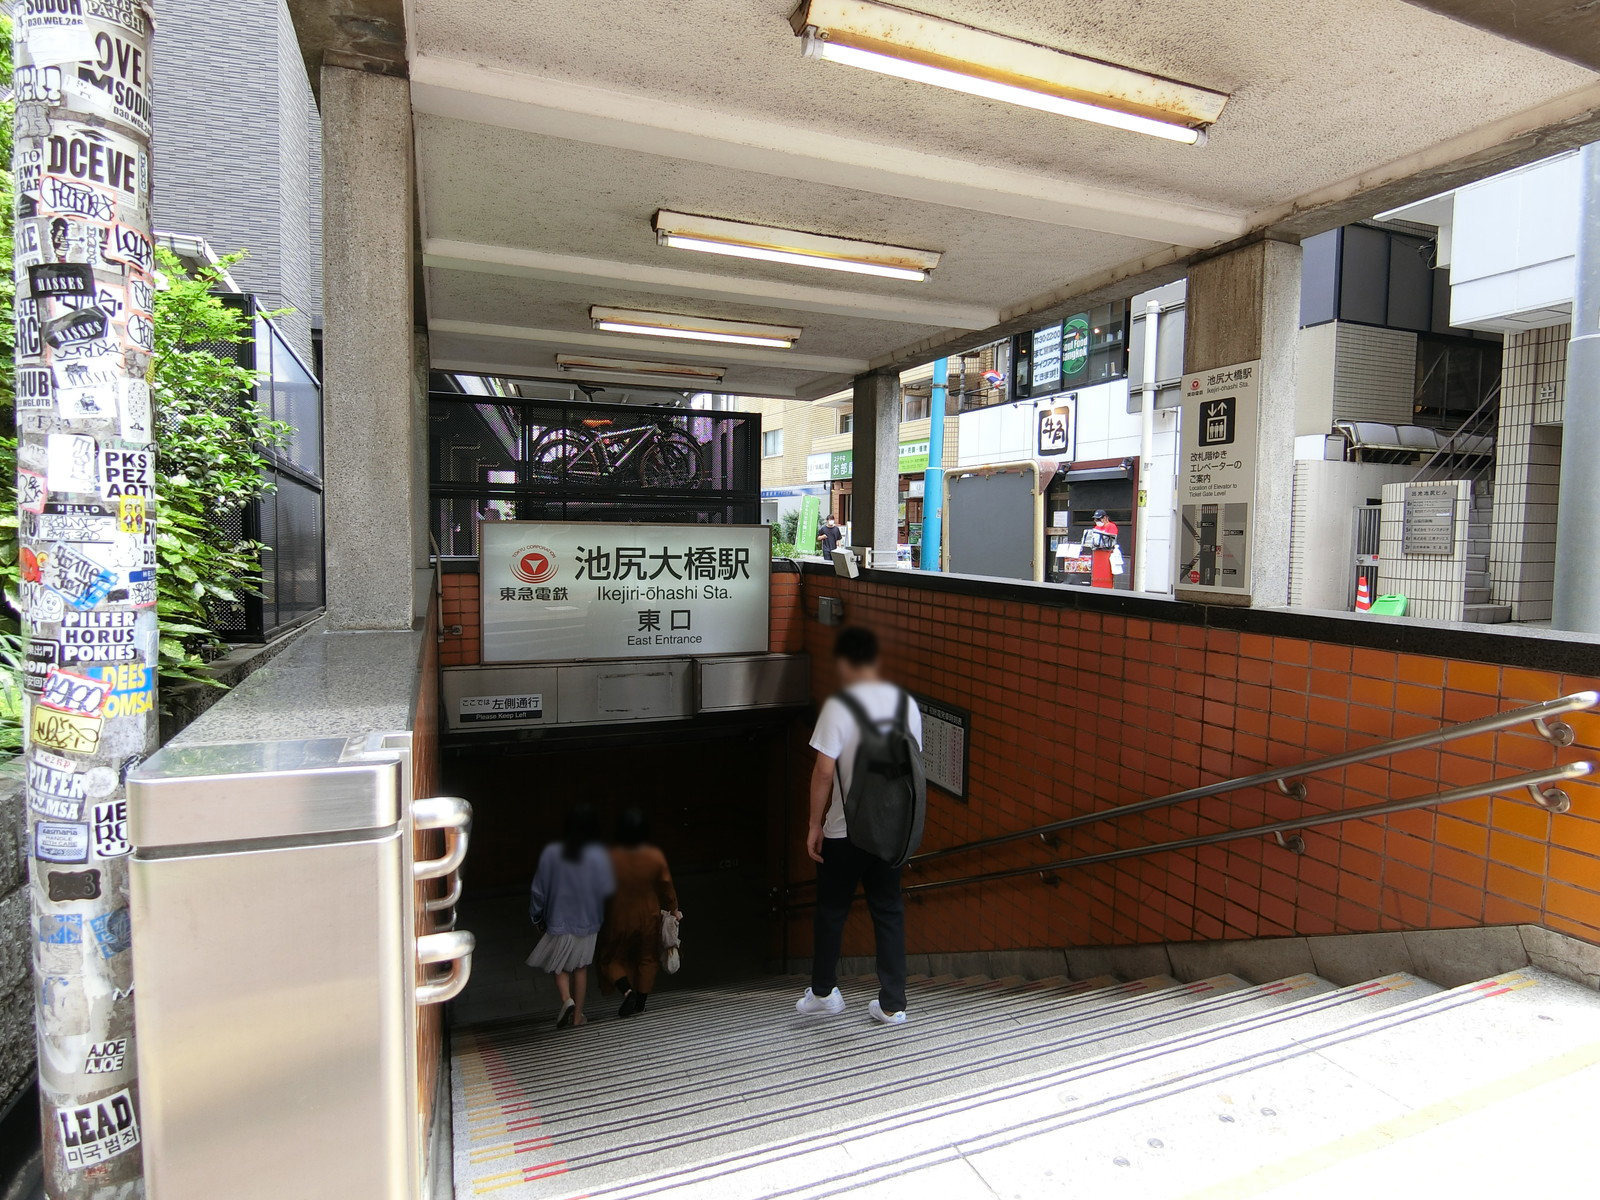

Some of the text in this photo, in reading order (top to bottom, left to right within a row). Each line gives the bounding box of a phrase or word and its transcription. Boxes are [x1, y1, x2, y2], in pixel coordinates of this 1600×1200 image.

[47, 135, 136, 195] DCEVE
[37, 276, 85, 292] MASSES
[54, 320, 103, 343] MASSES
[1207, 367, 1252, 386] 池尻大橋駅
[1042, 418, 1066, 445] 牛角
[105, 452, 147, 469] PKS
[1190, 450, 1227, 462] 改札階ゆき
[1190, 460, 1242, 473] エレベーターの
[106, 468, 147, 484] PEZ
[1189, 473, 1211, 484] ご案内
[57, 505, 100, 514] HELLO
[512, 544, 557, 559] TOKYU CORPORATION
[574, 545, 751, 582] 池尻大橋駅
[499, 586, 569, 601] 東急電鉄
[597, 585, 734, 604] Ikejiri-ōhashi Sta.
[65, 611, 136, 628] PILFER
[637, 608, 692, 633] 東口
[65, 628, 135, 644] HORUS
[627, 633, 703, 647] East Entrance
[64, 644, 135, 662] POKIES
[102, 663, 145, 690] DEES
[102, 691, 153, 719] OMSA
[462, 696, 540, 710] ここでは 左側通行
[475, 711, 527, 721] Please Keep Left
[29, 762, 84, 800] PILFER
[88, 1040, 126, 1058] AJOE
[85, 1056, 124, 1074] AJOE
[60, 1095, 133, 1147] LEAD
